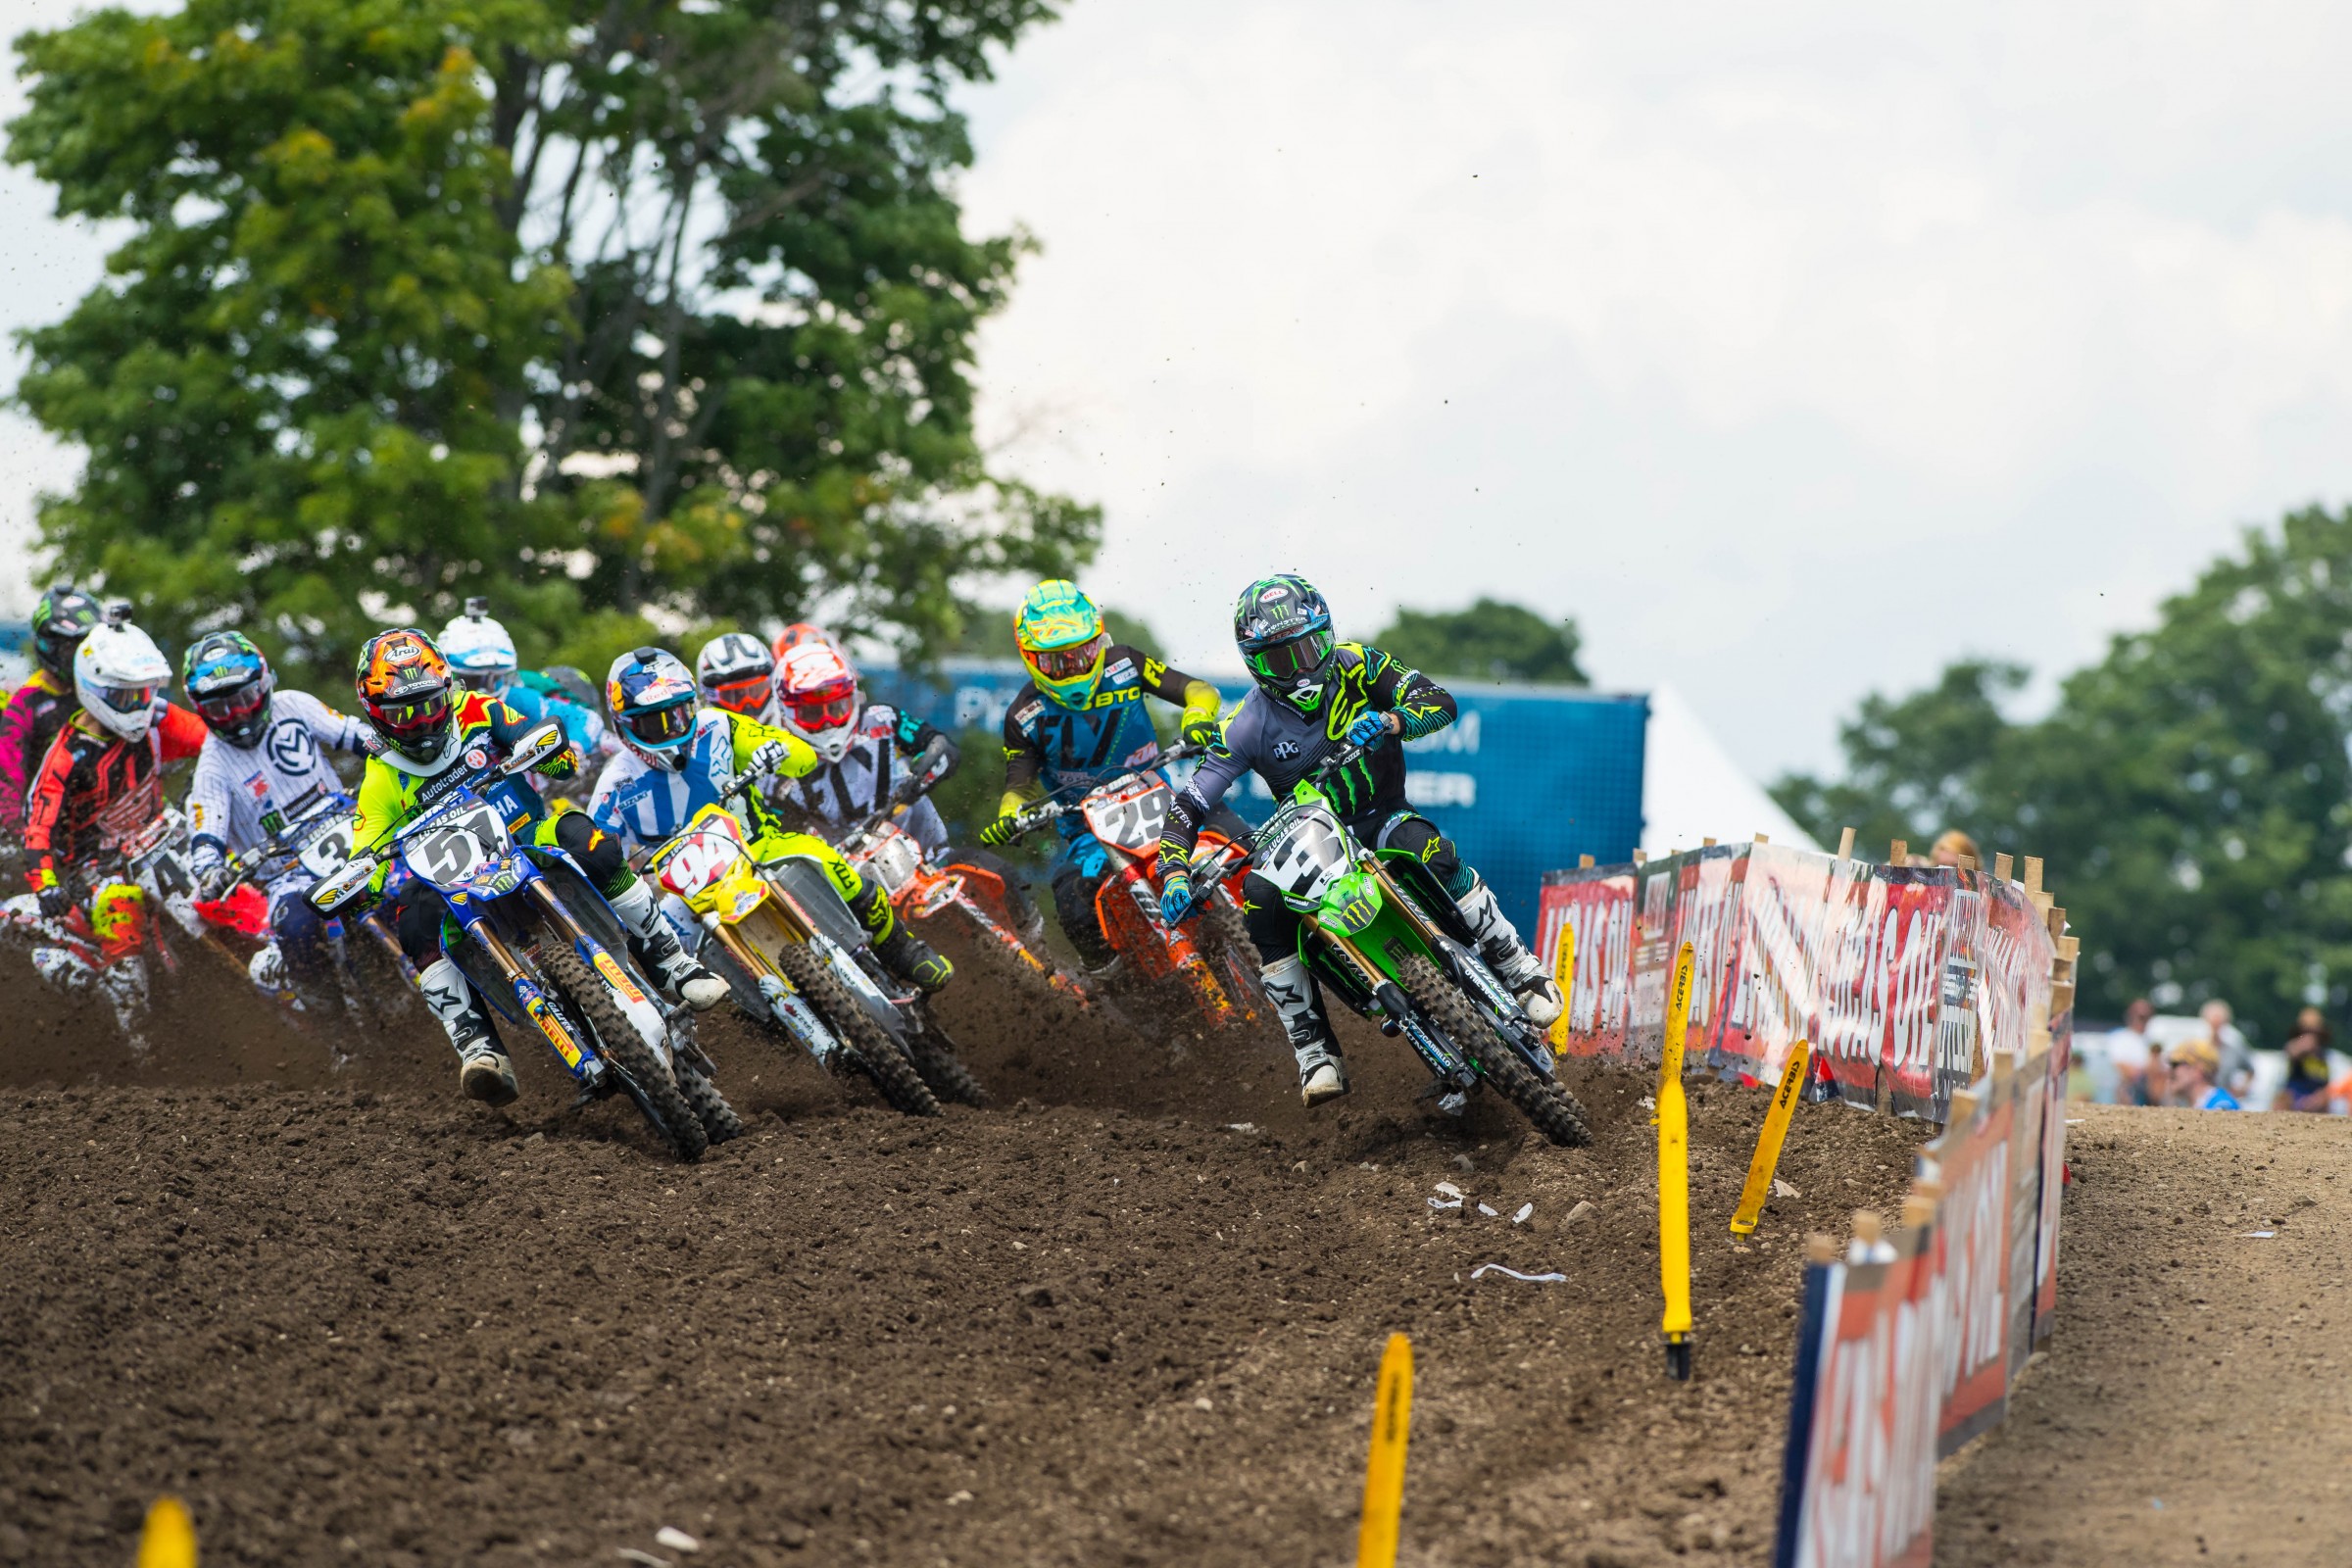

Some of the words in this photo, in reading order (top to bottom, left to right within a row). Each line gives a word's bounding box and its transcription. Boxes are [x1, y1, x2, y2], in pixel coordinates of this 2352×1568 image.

[1263, 590, 1284, 601] BELL
[392, 646, 416, 658] Arai
[407, 679, 438, 688] TOYOTA
[645, 690, 668, 703] Red
[1036, 708, 1124, 769] FLY
[1124, 742, 1159, 767] KTM
[421, 764, 468, 803] Autotrader
[617, 791, 649, 810] SUZUKI
[309, 816, 337, 841] LUCAS
[418, 814, 449, 842] LUCAS
[449, 807, 466, 819] OIL
[1104, 786, 1175, 849] 29
[1268, 826, 1289, 853] LUCAS
[1289, 817, 1302, 829] OIL
[318, 832, 353, 874] 3
[423, 809, 497, 886] 51
[669, 817, 740, 900] 94
[827, 858, 856, 890] FOX
[1284, 896, 1309, 906] Kawasaki
[599, 958, 647, 1004] PIRELLI
[1675, 963, 1689, 1012] ACERBIS
[1892, 907, 1942, 1070] OIL
[533, 1004, 575, 1057] IRELLI
[547, 1001, 575, 1032] GALFER
[1422, 1035, 1451, 1067] CARRILLO
[1779, 1060, 1801, 1110] ACERBIS
